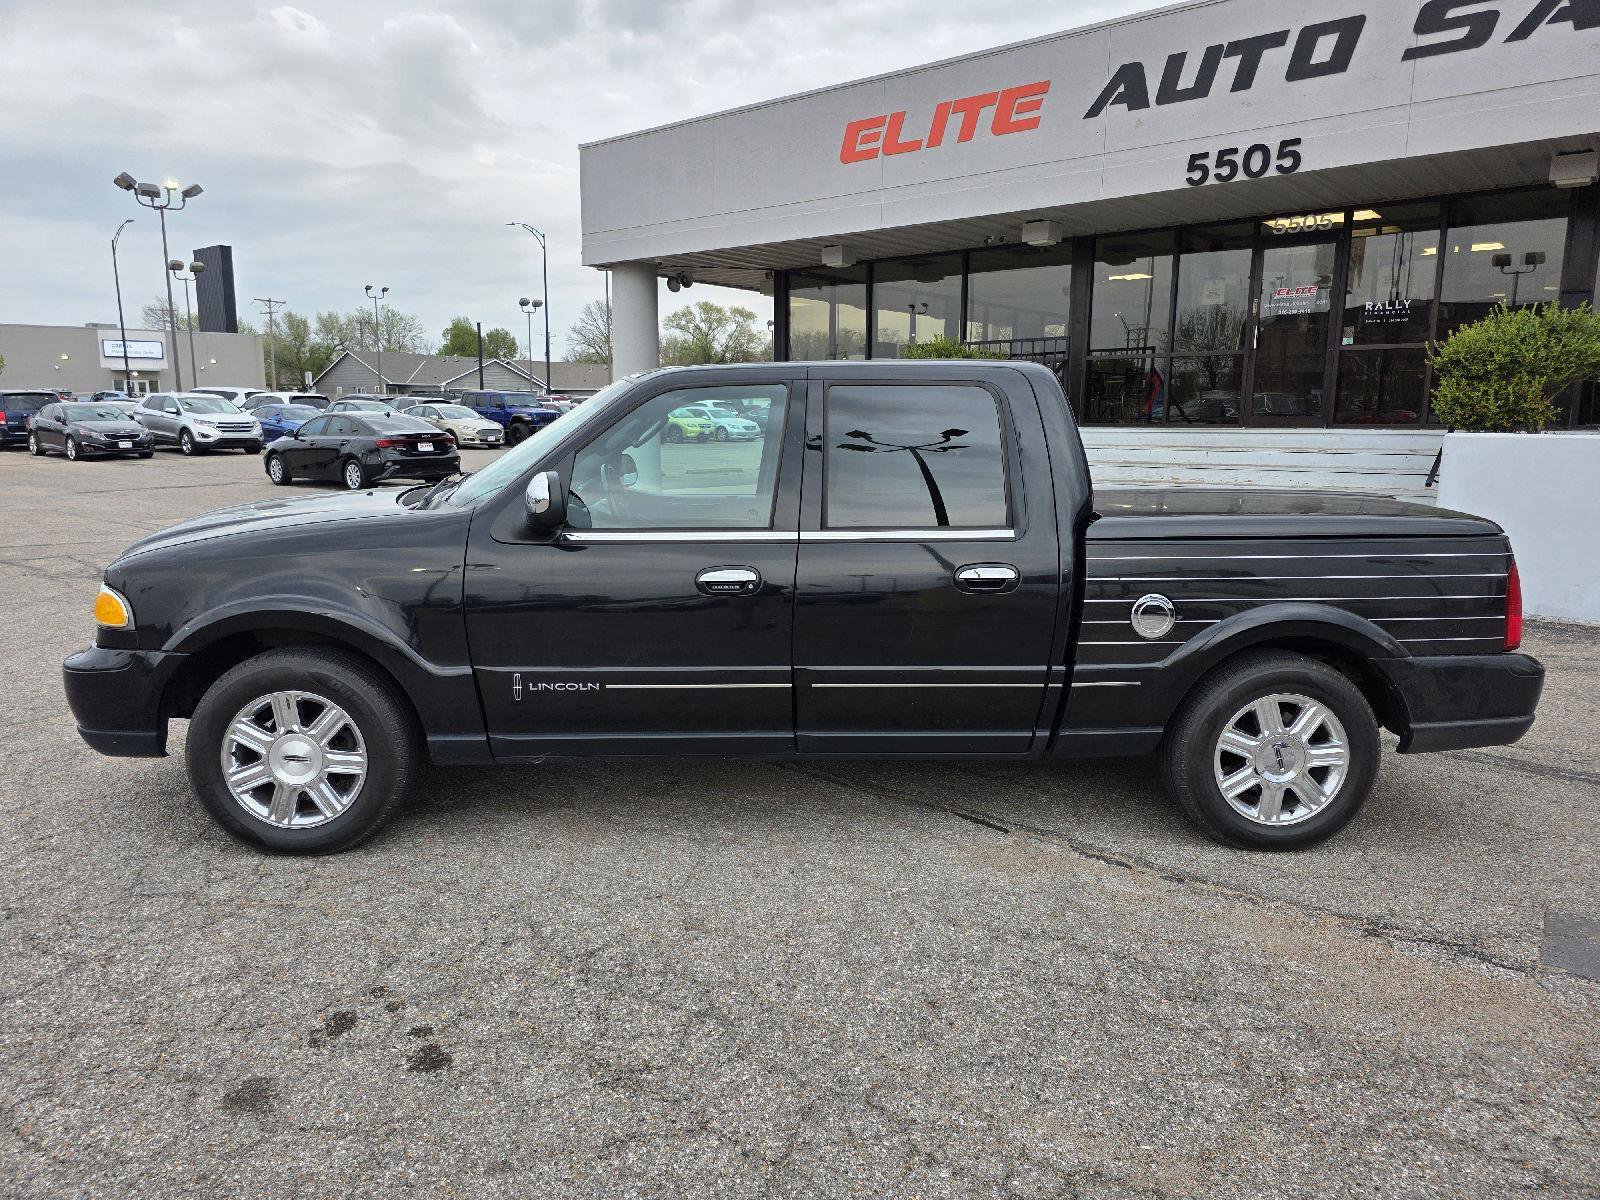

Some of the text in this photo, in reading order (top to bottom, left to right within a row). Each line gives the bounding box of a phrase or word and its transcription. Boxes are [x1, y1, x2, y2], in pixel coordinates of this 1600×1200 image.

[840, 80, 1050, 164] ELITE
[1082, 14, 1366, 119] AUTO
[1185, 137, 1302, 186] 5505
[1272, 213, 1333, 235] 5505
[1275, 285, 1319, 298] ELITE
[1365, 299, 1411, 311] RALLY
[529, 682, 600, 691] LINCOLN
